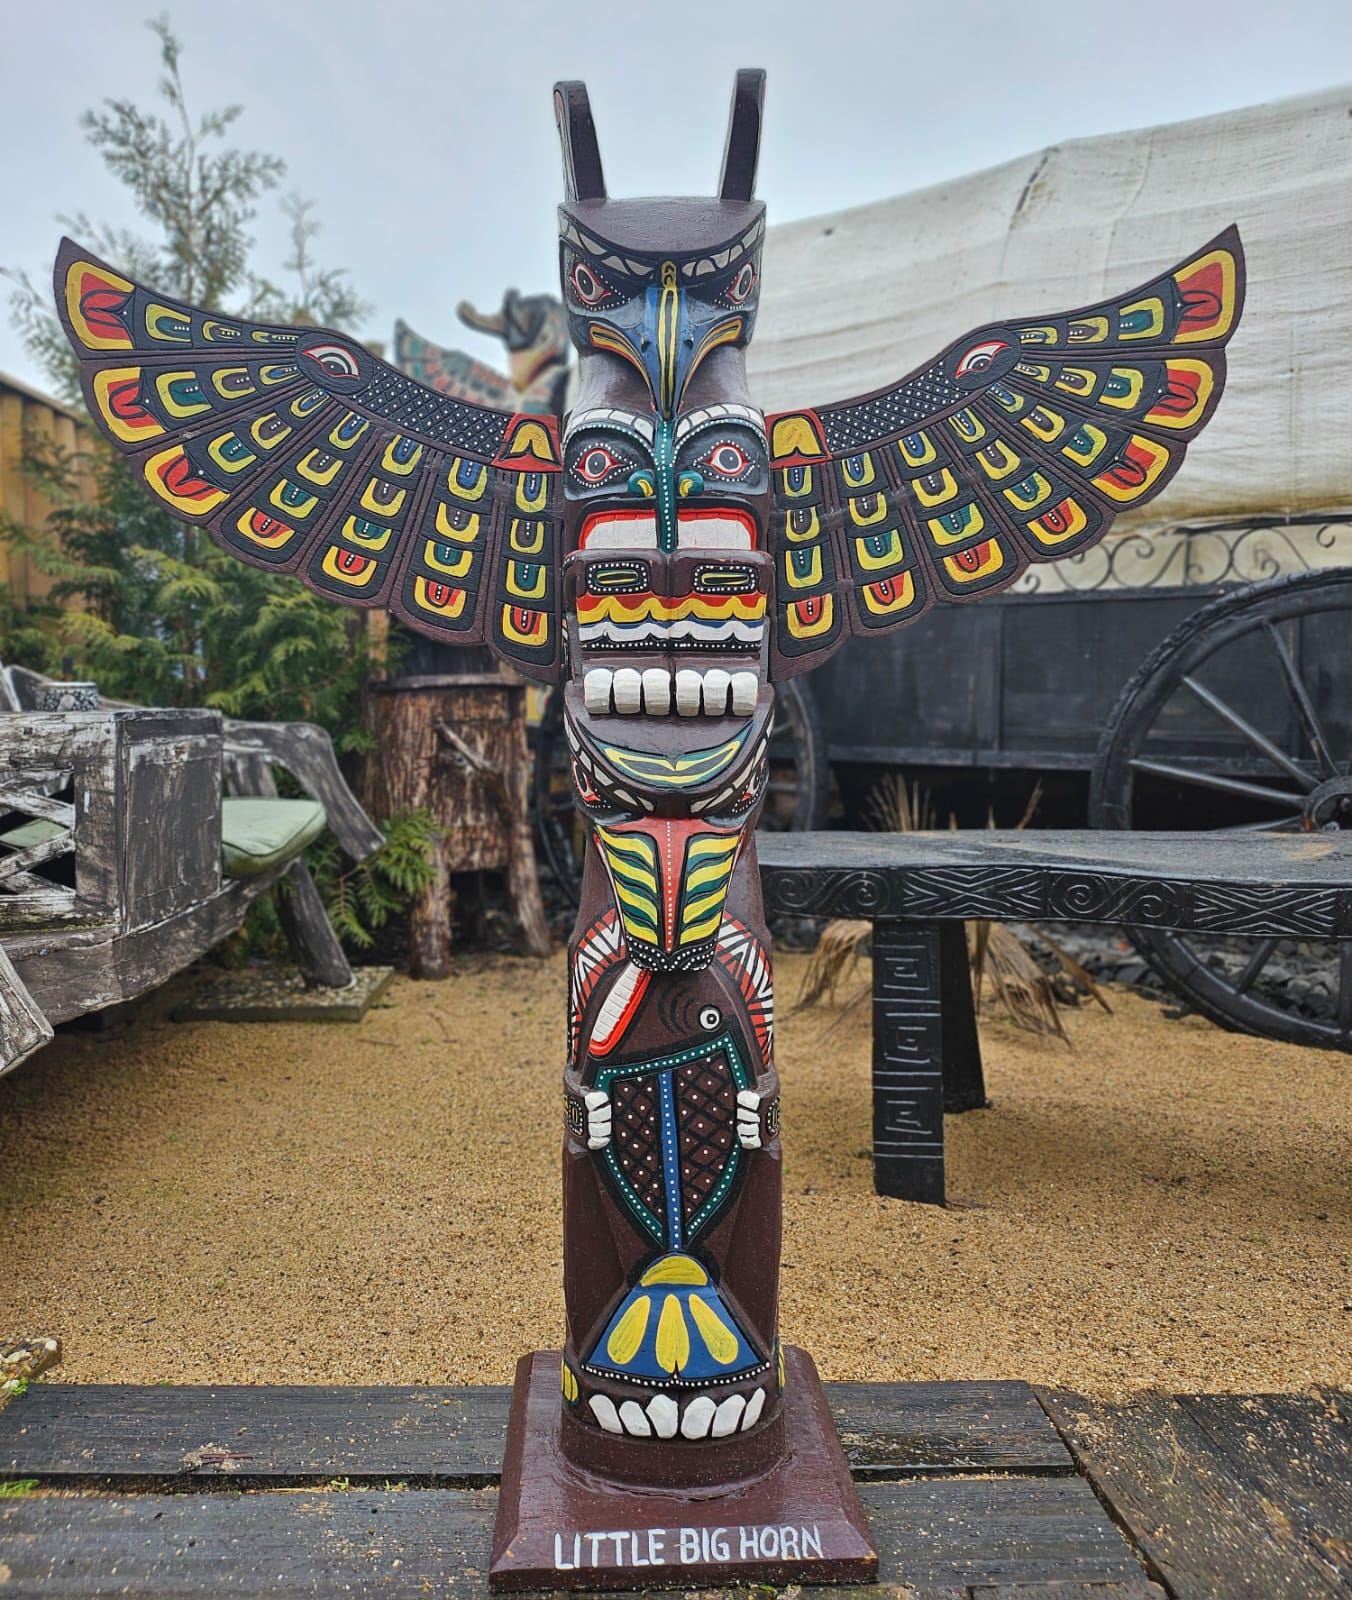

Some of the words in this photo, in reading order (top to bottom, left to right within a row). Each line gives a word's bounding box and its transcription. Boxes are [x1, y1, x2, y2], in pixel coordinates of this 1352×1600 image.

[554, 1528, 666, 1569] LITTLE
[680, 1527, 731, 1564] BIG
[738, 1524, 824, 1560] HORN
